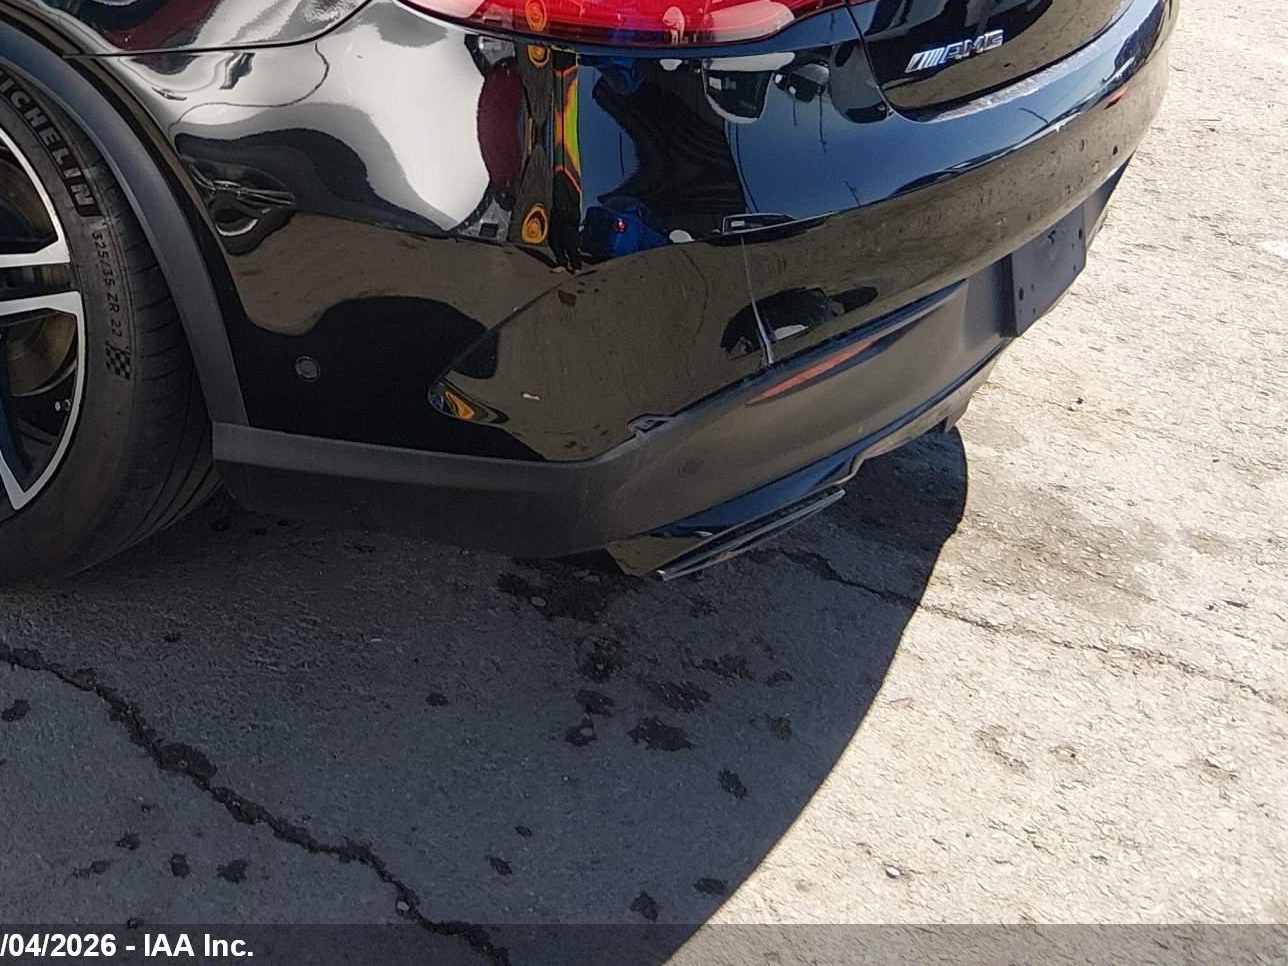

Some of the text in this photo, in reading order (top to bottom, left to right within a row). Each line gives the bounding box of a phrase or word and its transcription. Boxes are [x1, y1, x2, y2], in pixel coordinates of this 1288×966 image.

[91, 232, 122, 338] 325/35 ZR 22
